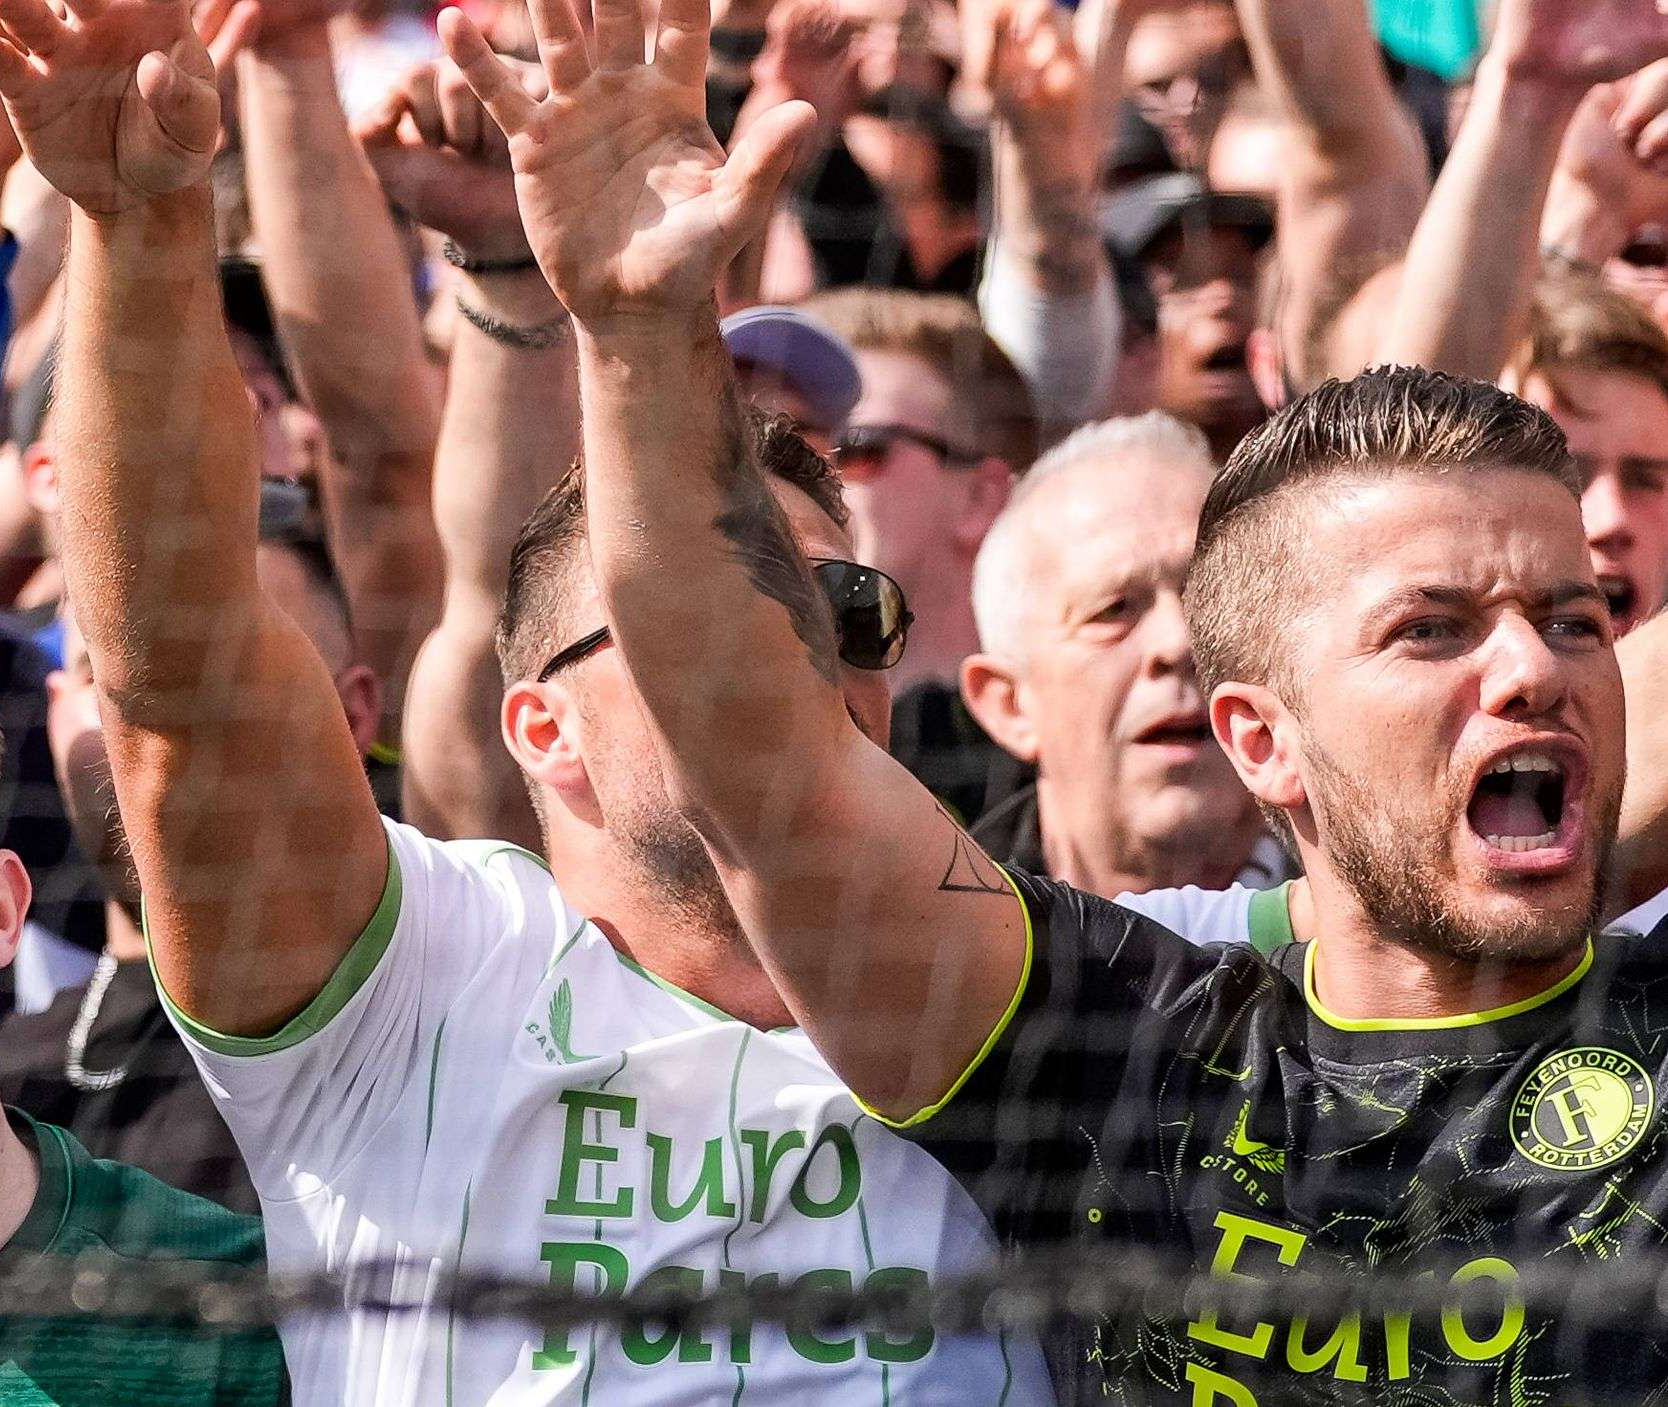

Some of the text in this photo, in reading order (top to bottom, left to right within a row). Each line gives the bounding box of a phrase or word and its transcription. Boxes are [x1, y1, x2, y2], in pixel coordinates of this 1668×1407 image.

[1516, 1052, 1632, 1118] FEYENOORD
[1528, 1103, 1648, 1166] ROTTERDAM
[545, 1089, 863, 1223] Euro
[1186, 1210, 1526, 1383] Euro
